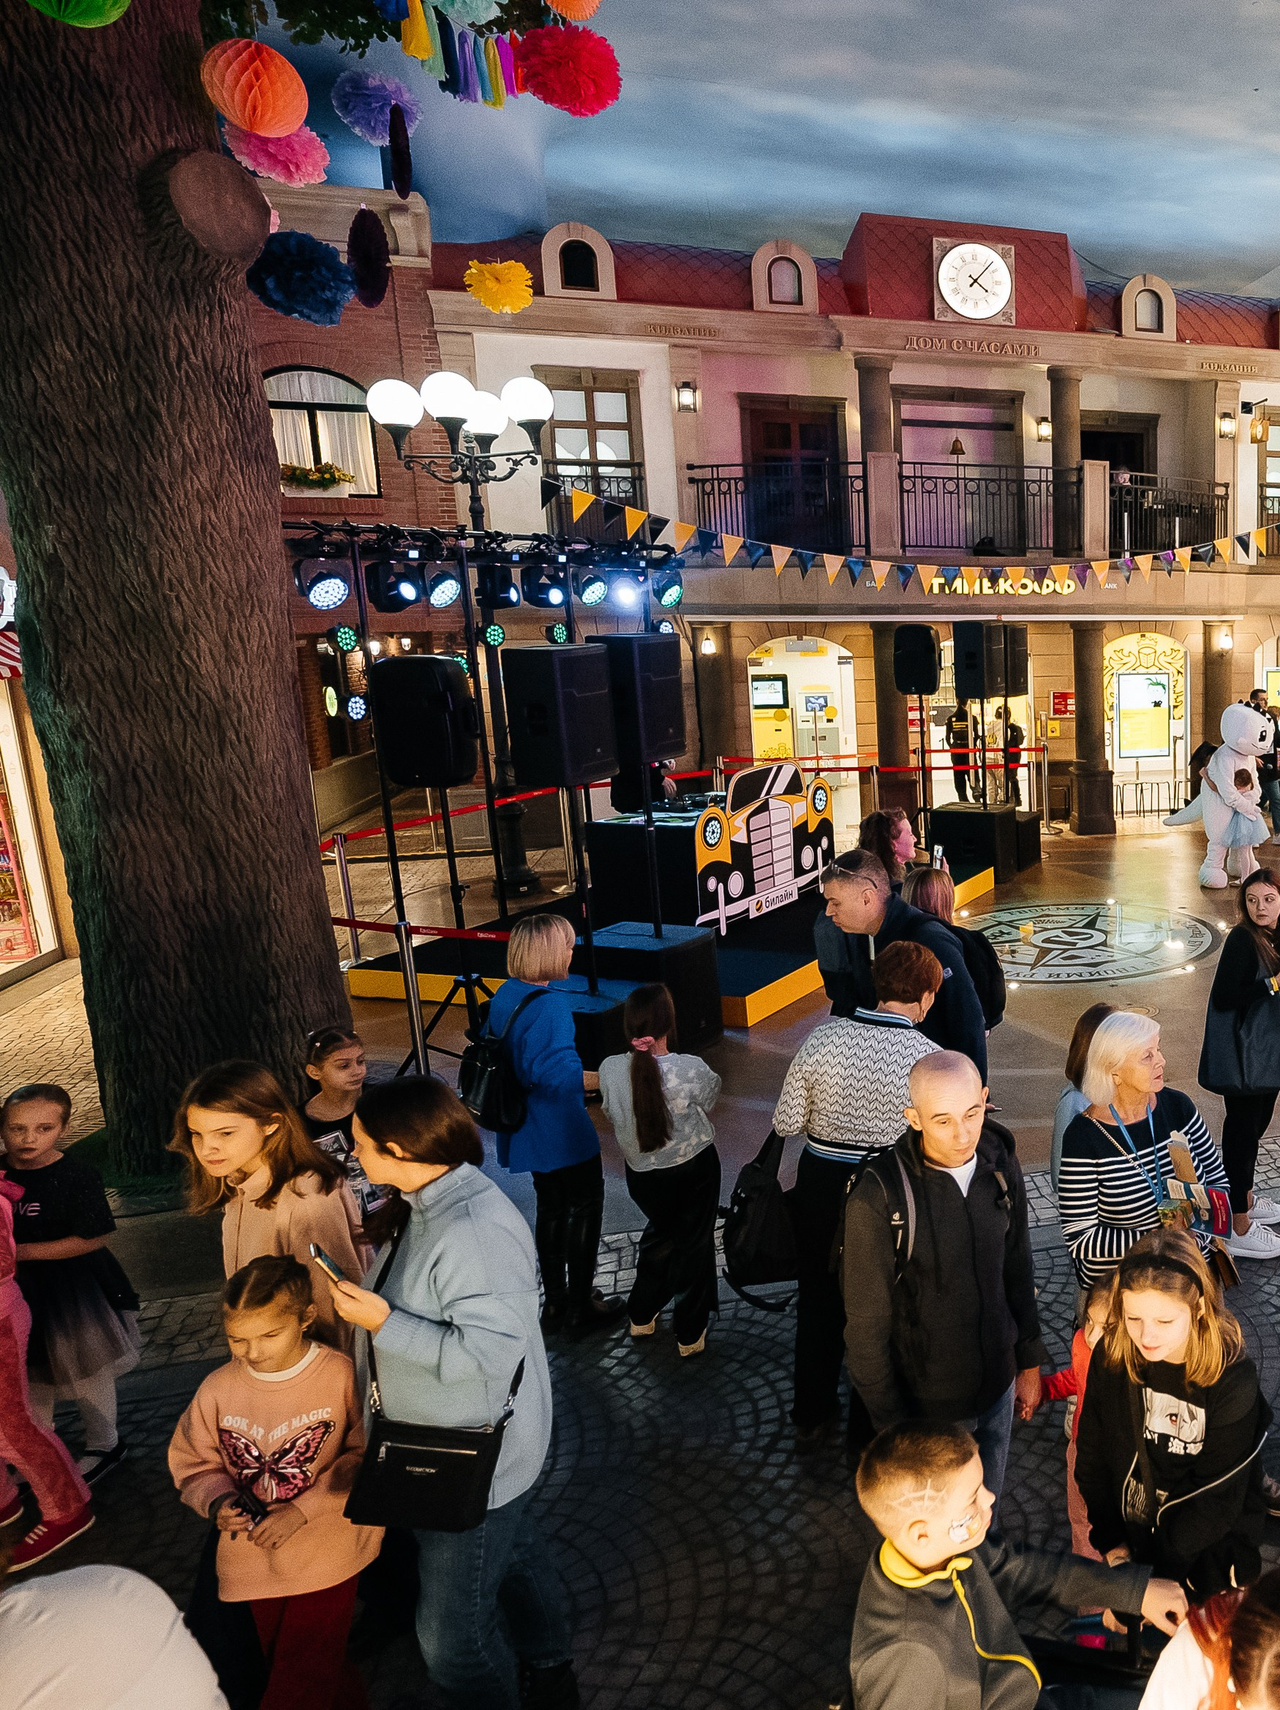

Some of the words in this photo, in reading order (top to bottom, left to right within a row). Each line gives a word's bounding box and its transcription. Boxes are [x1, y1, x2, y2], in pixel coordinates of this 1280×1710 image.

[645, 324, 719, 338] КИДЗАНИЯ
[905, 336, 947, 350] ДОМ
[951, 339, 963, 351] С
[965, 341, 1042, 357] ЧАСАМИ
[1200, 362, 1258, 373] КИДЗАНИЯ
[865, 580, 887, 588] БАК
[1102, 582, 1118, 590] ANK
[764, 889, 794, 909] билайн
[220, 1415, 249, 1431] OOK
[268, 1422, 289, 1443] THE
[291, 1407, 332, 1429] MAGIC
